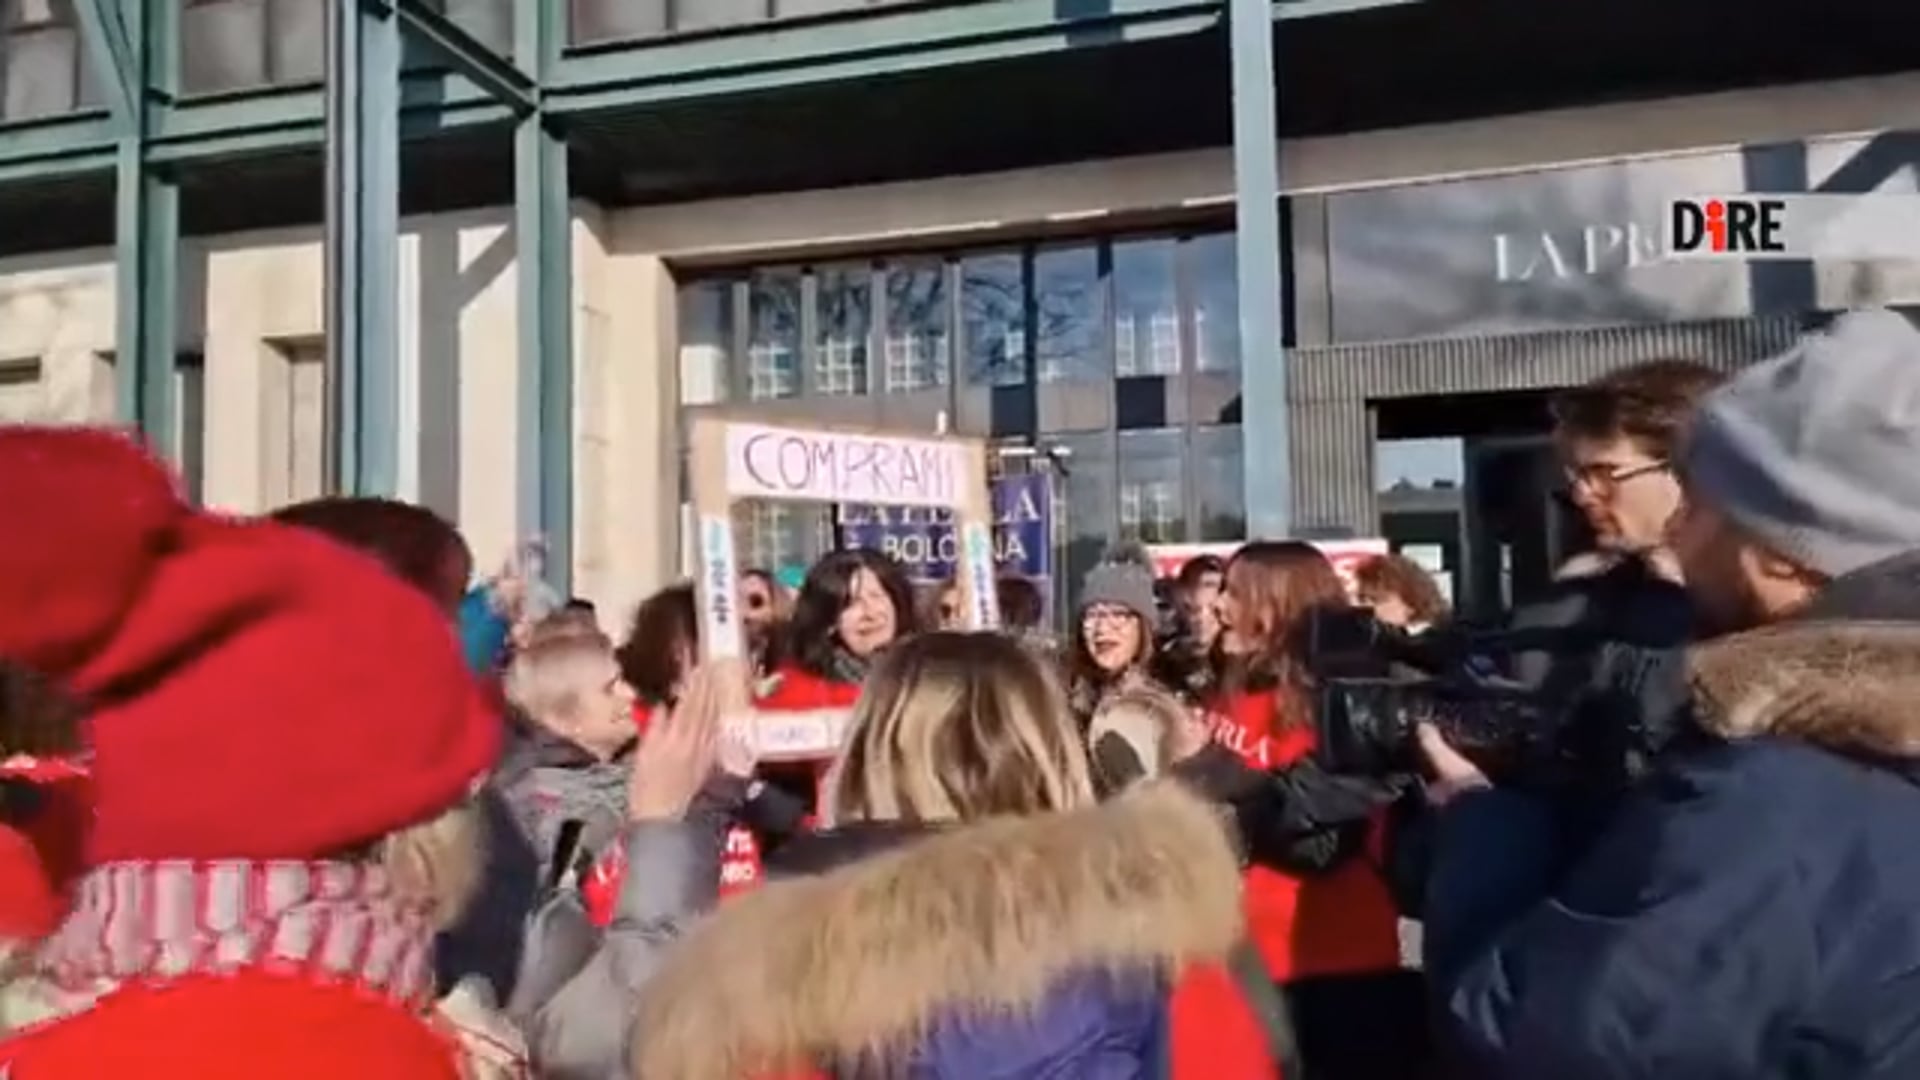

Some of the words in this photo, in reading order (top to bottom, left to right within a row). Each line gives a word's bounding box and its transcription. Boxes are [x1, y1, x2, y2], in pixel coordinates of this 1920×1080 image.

[1494, 231, 1569, 281] LA
[743, 432, 954, 497] COMPRAMI
[883, 531, 1027, 563] BOLOA
